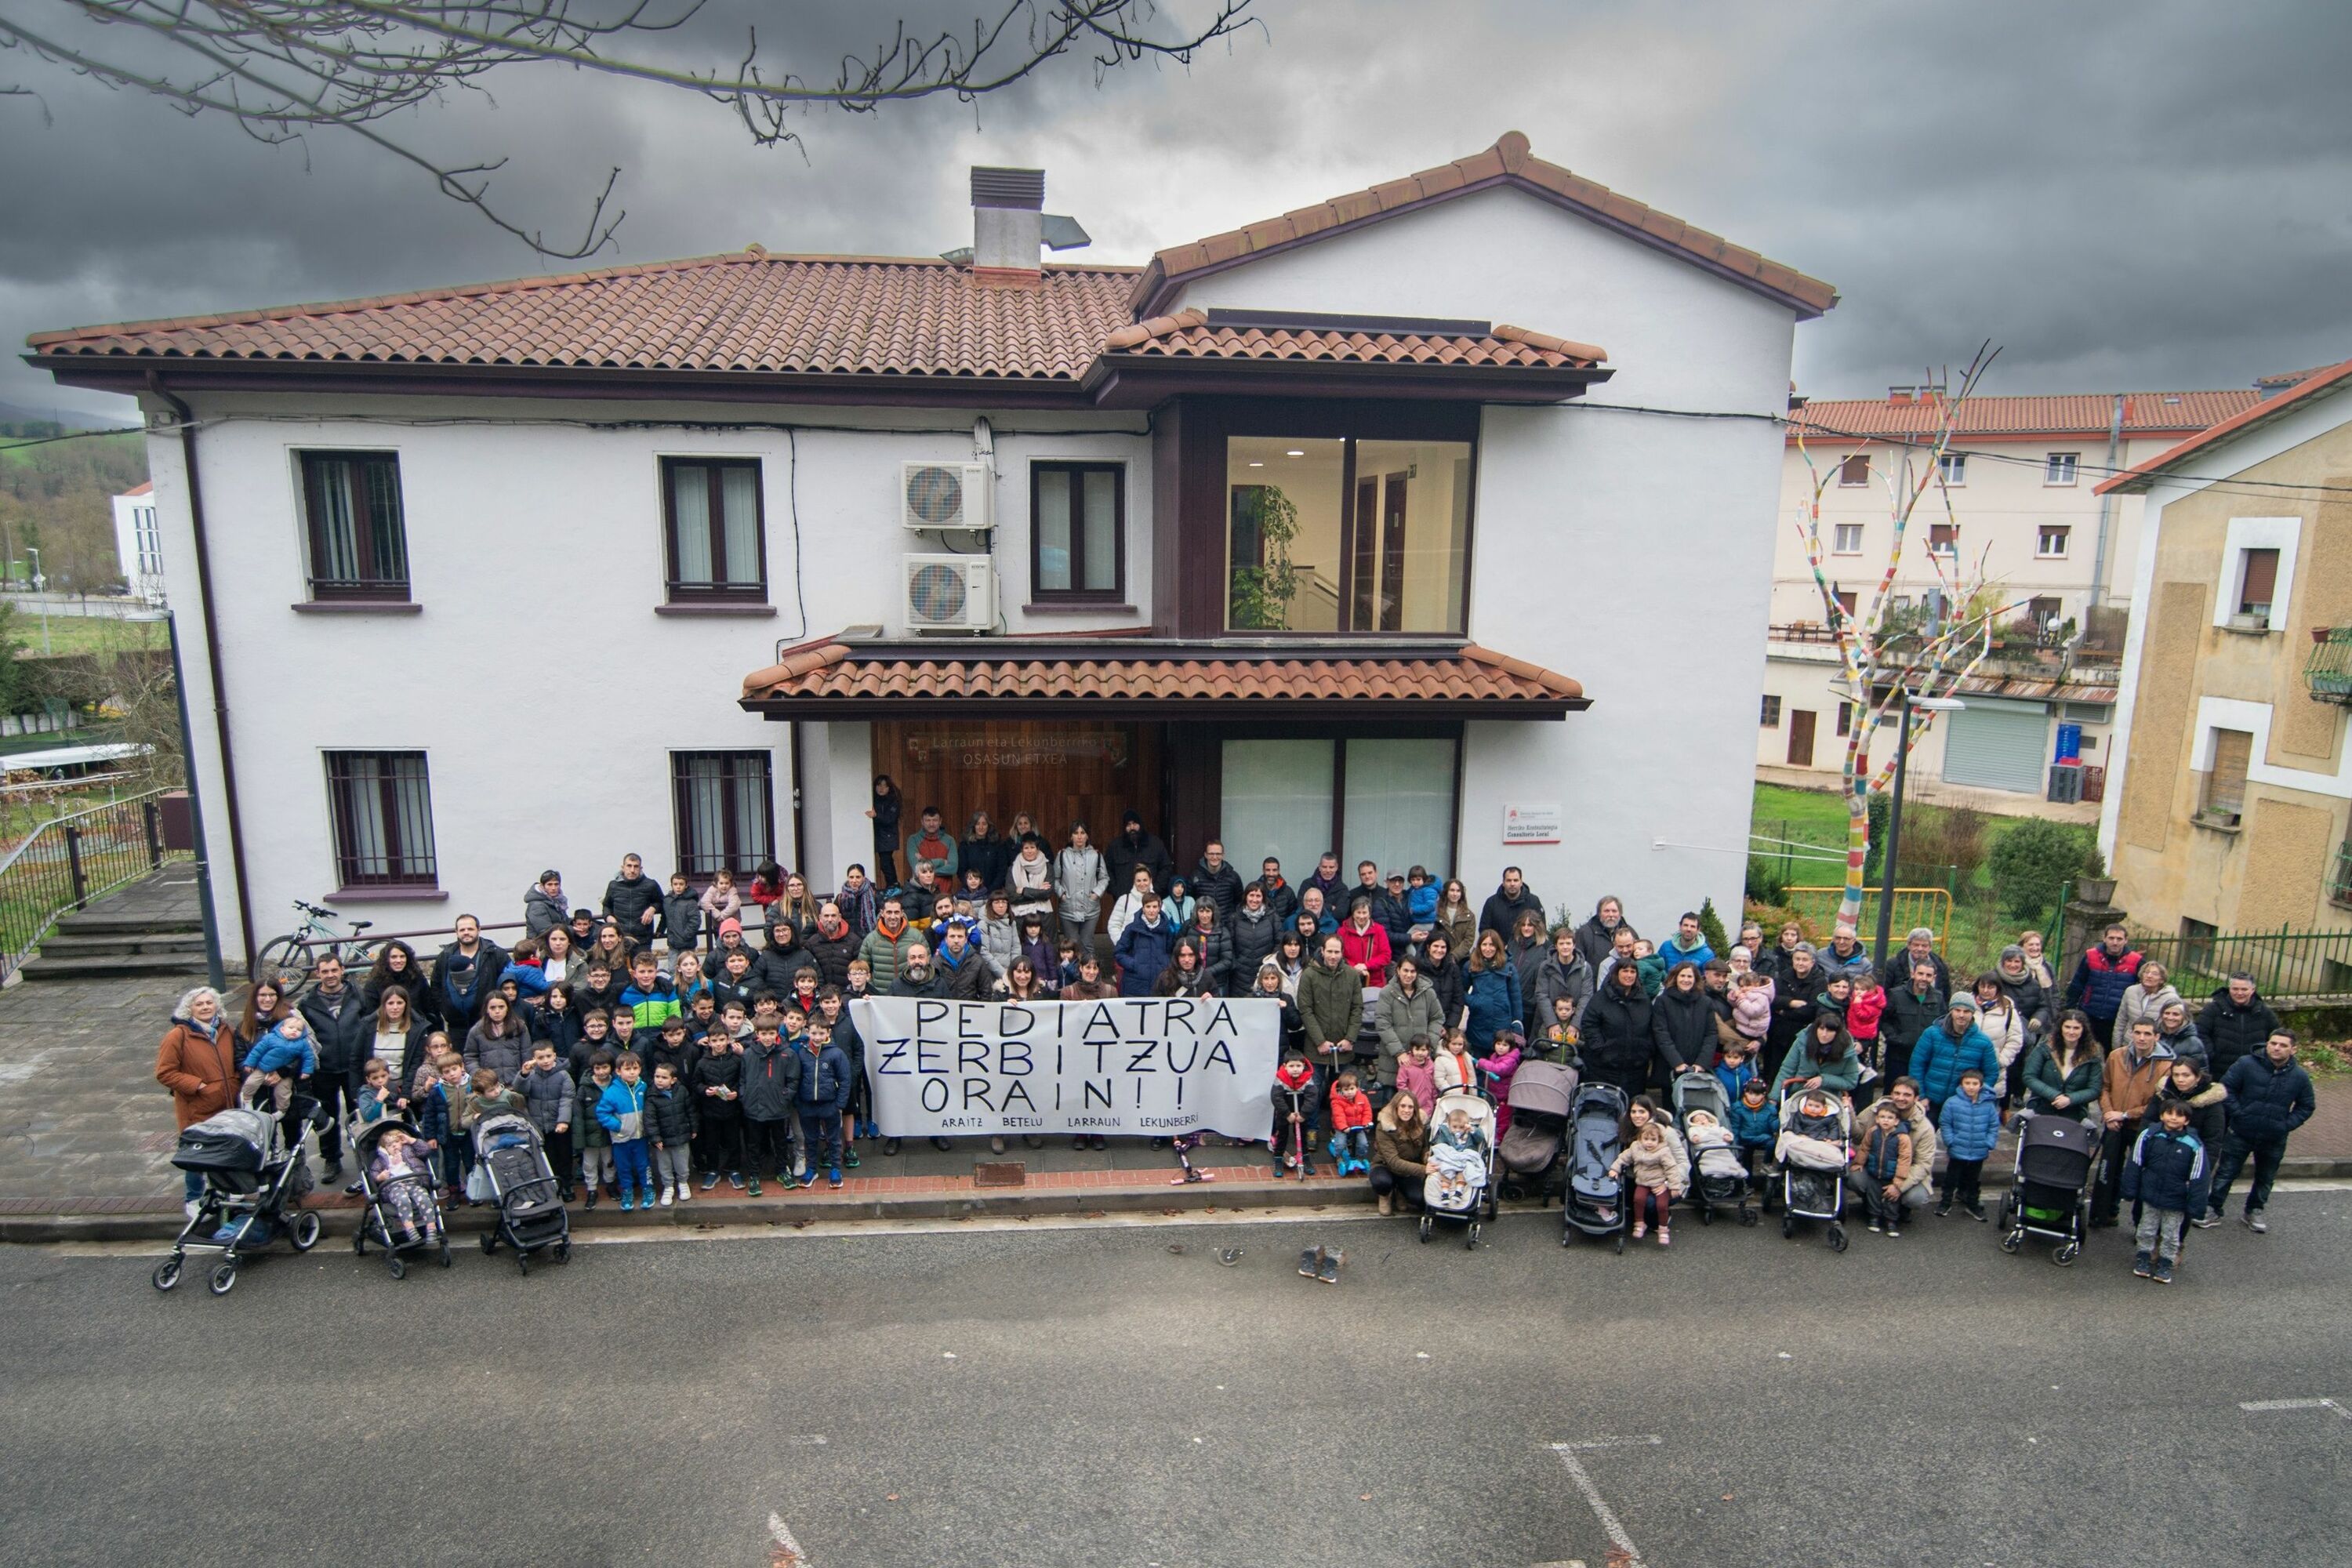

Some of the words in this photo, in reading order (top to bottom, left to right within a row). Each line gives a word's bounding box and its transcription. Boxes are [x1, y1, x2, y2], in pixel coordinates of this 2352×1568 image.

[933, 737, 983, 748] Larraun
[987, 739, 1008, 748] eta
[963, 753, 1022, 765] OSASUN
[1025, 753, 1068, 765] ETXEA
[916, 1000, 1238, 1040] PEDIATRA
[877, 1038, 1237, 1076] ZERBITZUA
[922, 1076, 1183, 1112] ORAIN!!
[1003, 1117, 1043, 1127] BETELU
[1068, 1117, 1120, 1127] LARRAUN
